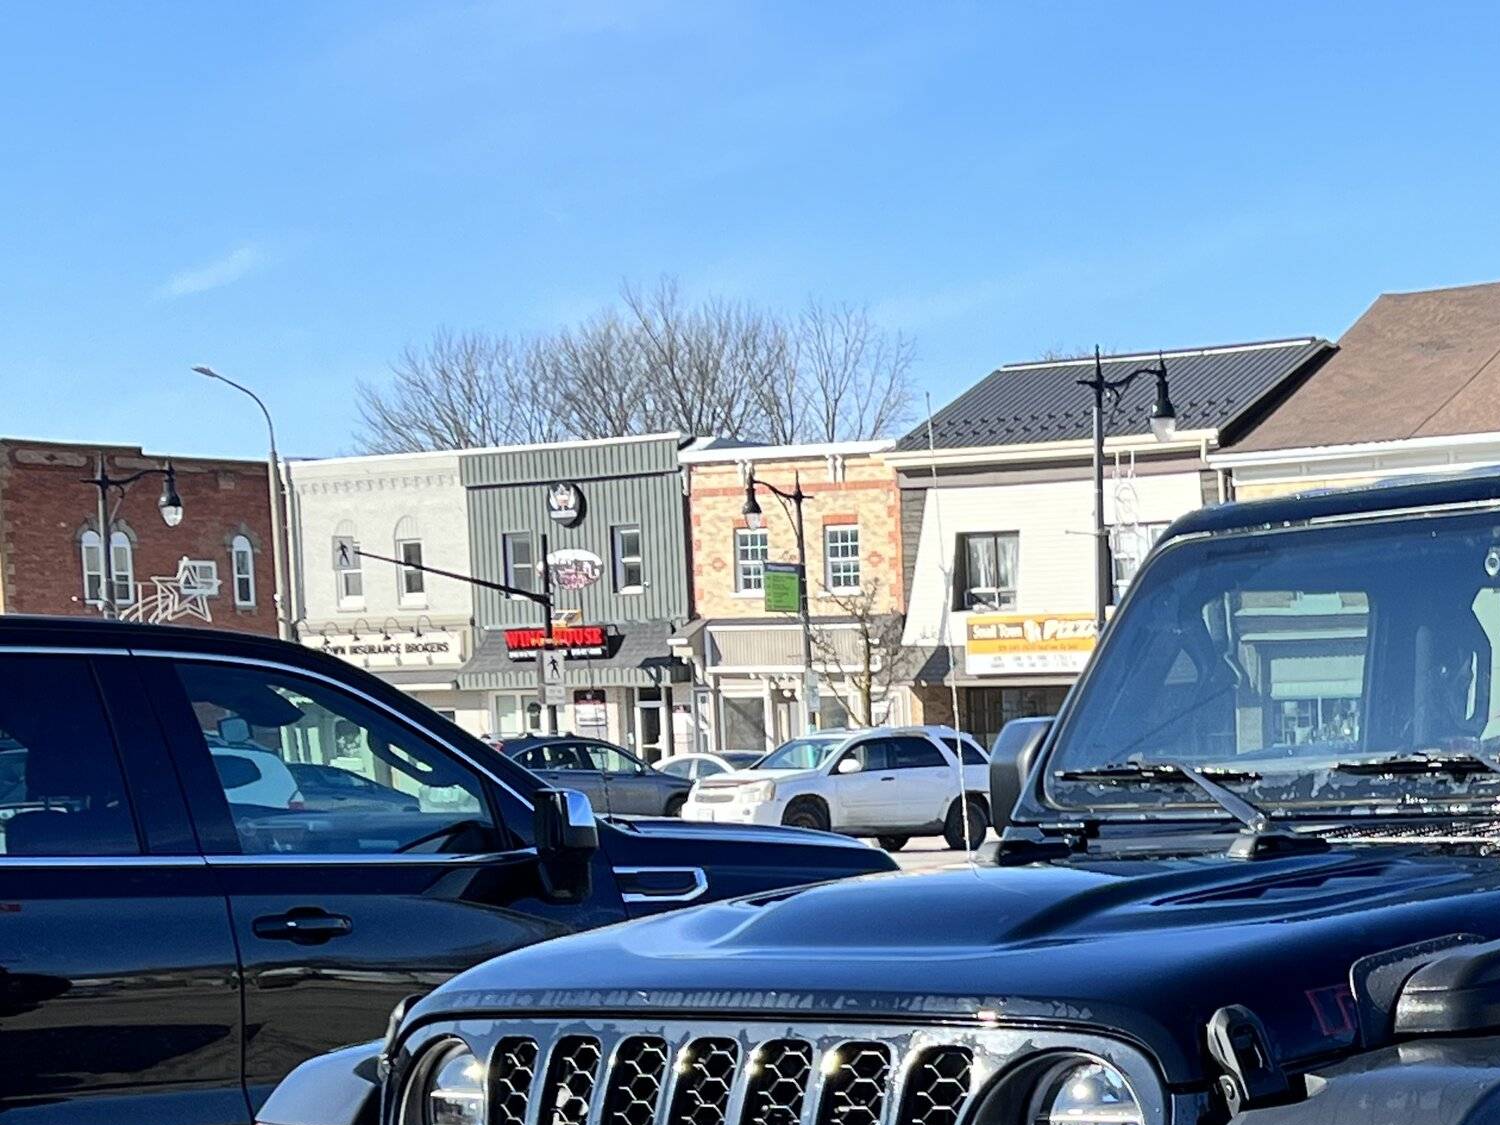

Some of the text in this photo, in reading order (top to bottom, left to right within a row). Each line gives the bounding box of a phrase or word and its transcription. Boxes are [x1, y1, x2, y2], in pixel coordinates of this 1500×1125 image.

[505, 627, 602, 649] WING HOUSE
[349, 643, 401, 656] INSURANCE
[405, 641, 449, 654] BROKERS
